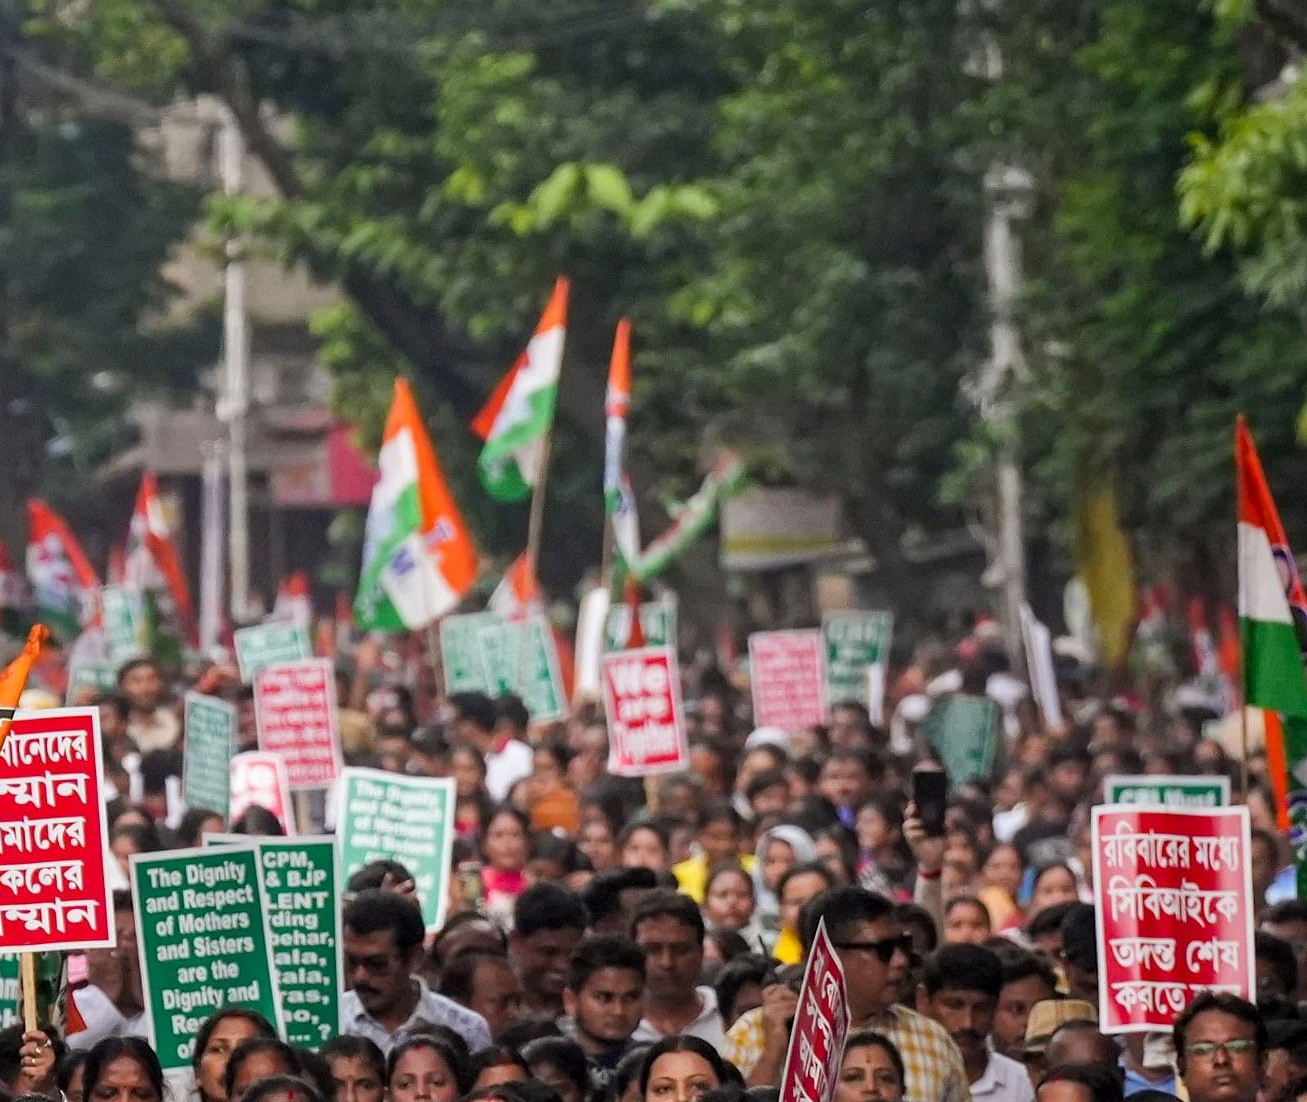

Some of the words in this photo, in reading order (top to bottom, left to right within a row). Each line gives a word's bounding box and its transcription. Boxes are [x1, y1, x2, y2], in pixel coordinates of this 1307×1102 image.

[263, 851, 314, 870] CPM,
[1100, 821, 1190, 869] রবিবারের
[1192, 834, 1239, 872] মধ্যে
[147, 867, 183, 889] The
[186, 860, 246, 886] Dignity
[287, 870, 327, 887] BJP
[146, 891, 179, 913] and
[183, 884, 254, 910] Respect
[1107, 873, 1239, 927] সিবিআইকে
[155, 916, 175, 937] of
[178, 912, 250, 934] Mothers
[156, 939, 190, 962] and
[193, 935, 255, 957] Sisters
[1109, 937, 1177, 972] তদন্ত
[1187, 935, 1240, 973] শেষ
[177, 965, 208, 984] are
[211, 960, 239, 980] the
[162, 985, 224, 1012] Dignity
[227, 980, 260, 1002] and
[1111, 981, 1187, 1015] করতে
